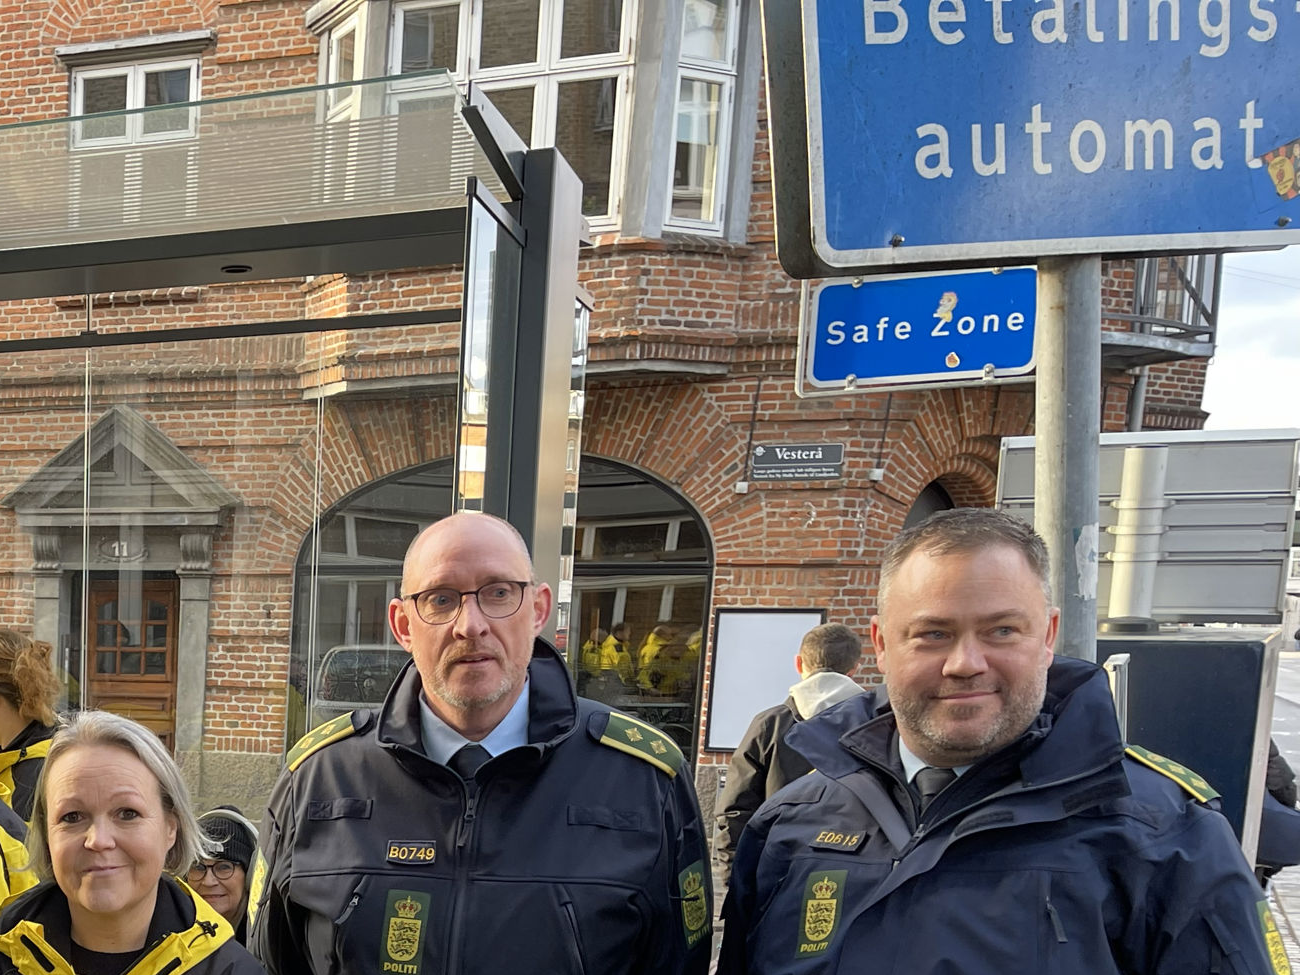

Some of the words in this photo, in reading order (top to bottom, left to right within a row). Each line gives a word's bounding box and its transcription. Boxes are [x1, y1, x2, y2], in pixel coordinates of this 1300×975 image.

[864, 0, 1300, 57] Betalings
[915, 100, 1263, 179] automat
[826, 317, 912, 345] Safe
[931, 312, 1025, 337] Zone
[775, 447, 823, 460] Vesterå
[800, 942, 828, 952] POLITI
[383, 962, 418, 974] POLITI
